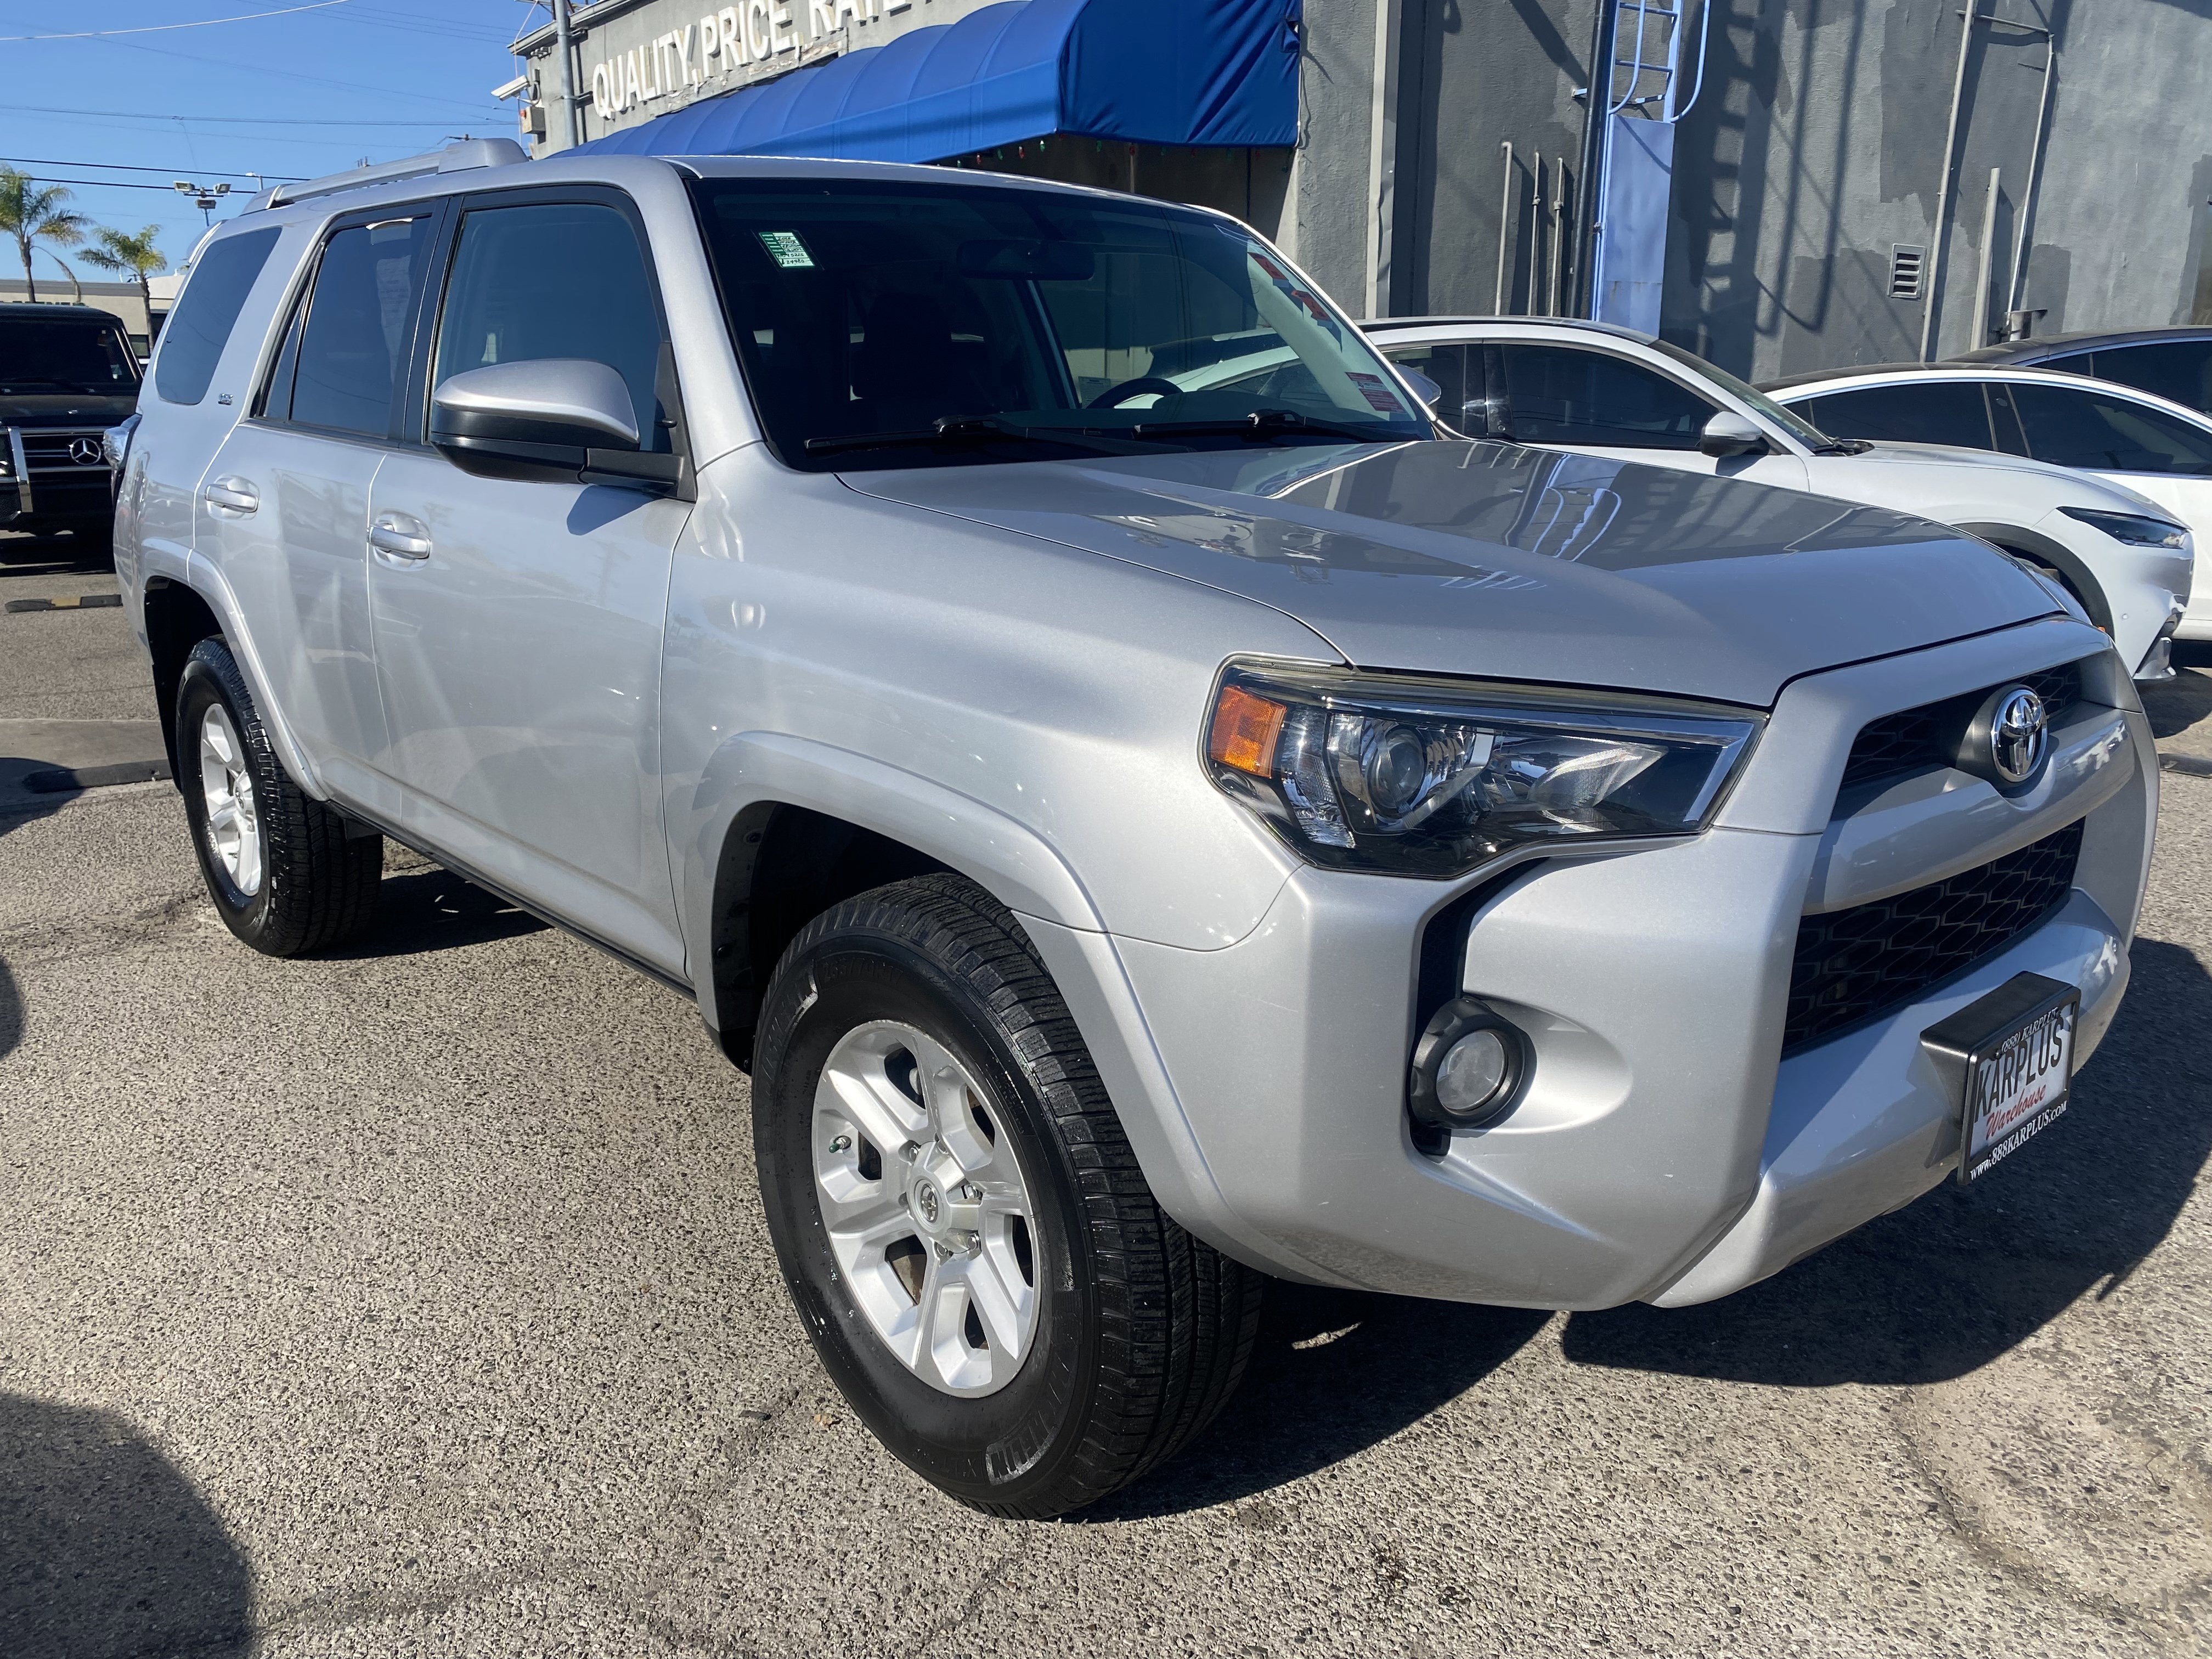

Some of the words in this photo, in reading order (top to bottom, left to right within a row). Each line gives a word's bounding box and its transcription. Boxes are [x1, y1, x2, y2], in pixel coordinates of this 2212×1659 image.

[592, 25, 698, 119] QUALITY,
[699, 0, 800, 78] PRICE,
[1975, 1016, 2064, 1124] KARPLUS
[1985, 1084, 2046, 1141] Warehouse
